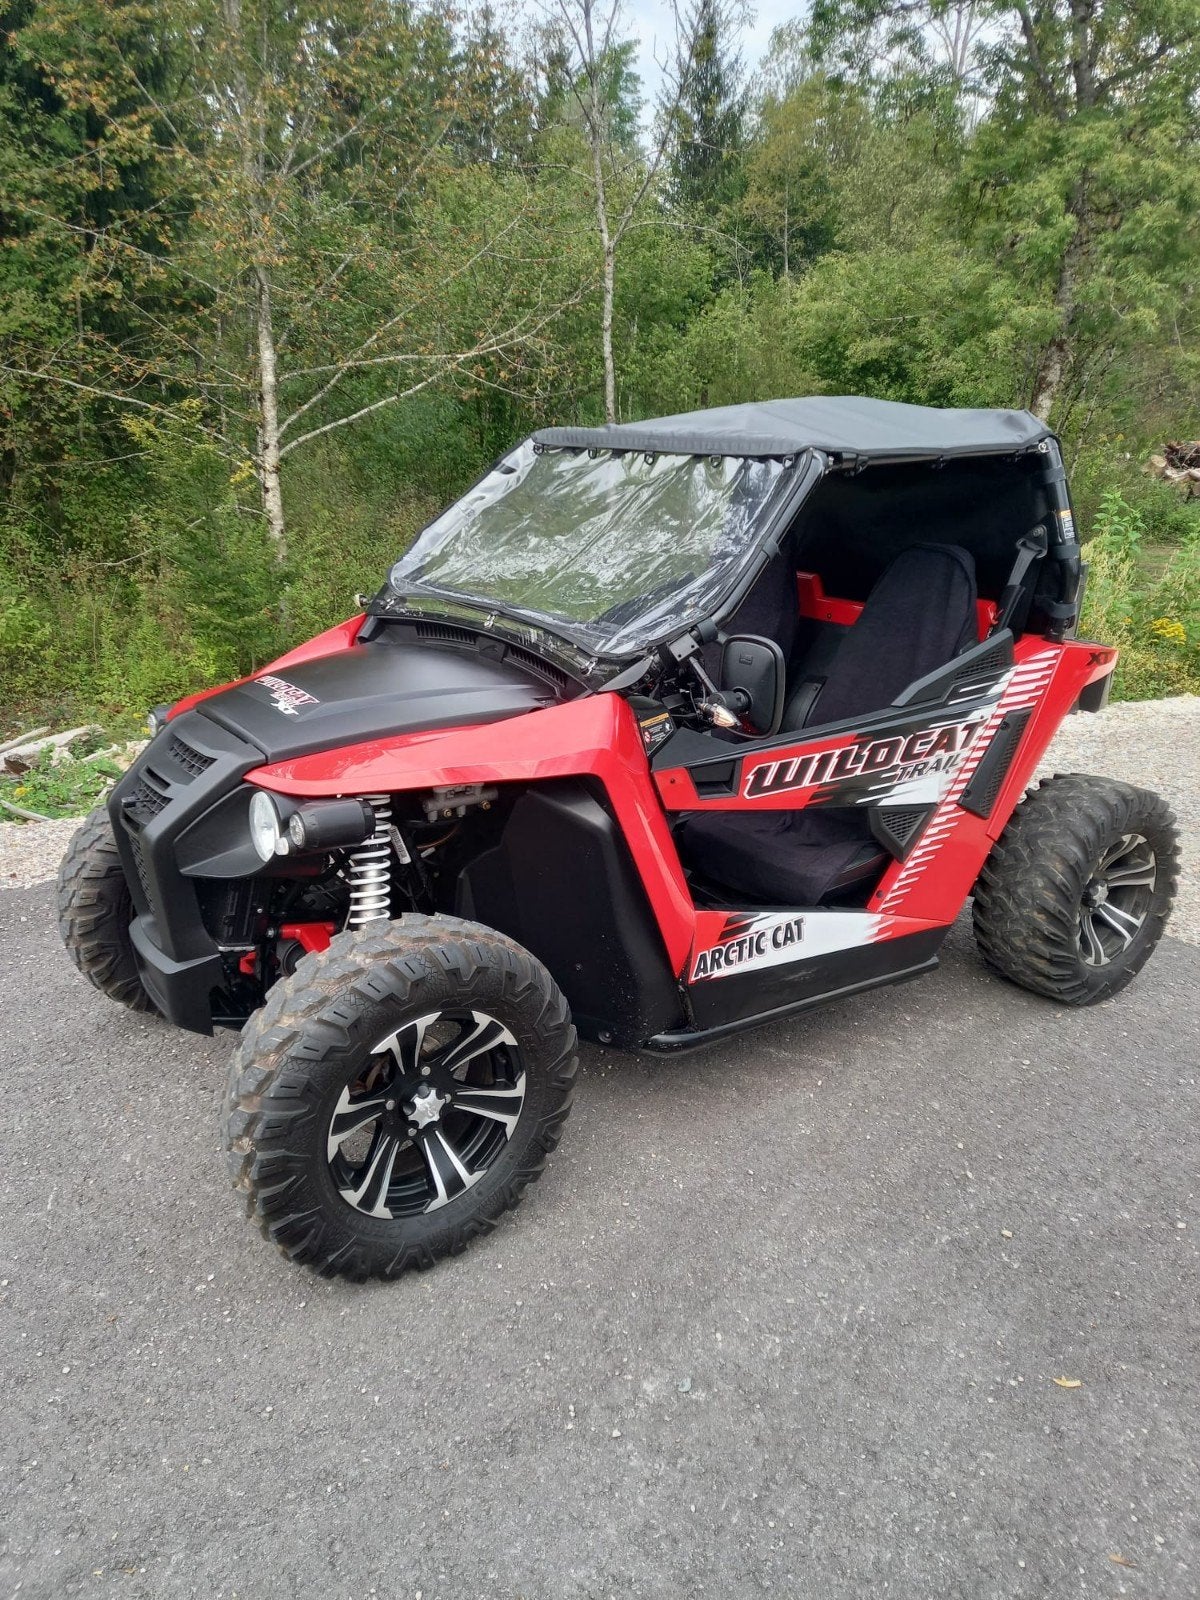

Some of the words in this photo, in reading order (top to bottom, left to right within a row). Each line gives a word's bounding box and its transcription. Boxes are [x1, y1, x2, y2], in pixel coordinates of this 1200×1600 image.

[1085, 652, 1111, 666] XT
[744, 717, 988, 799] WILDCAT
[896, 754, 960, 782] TRAIL
[692, 930, 767, 979] ARCTIC
[771, 916, 805, 949] CAT
